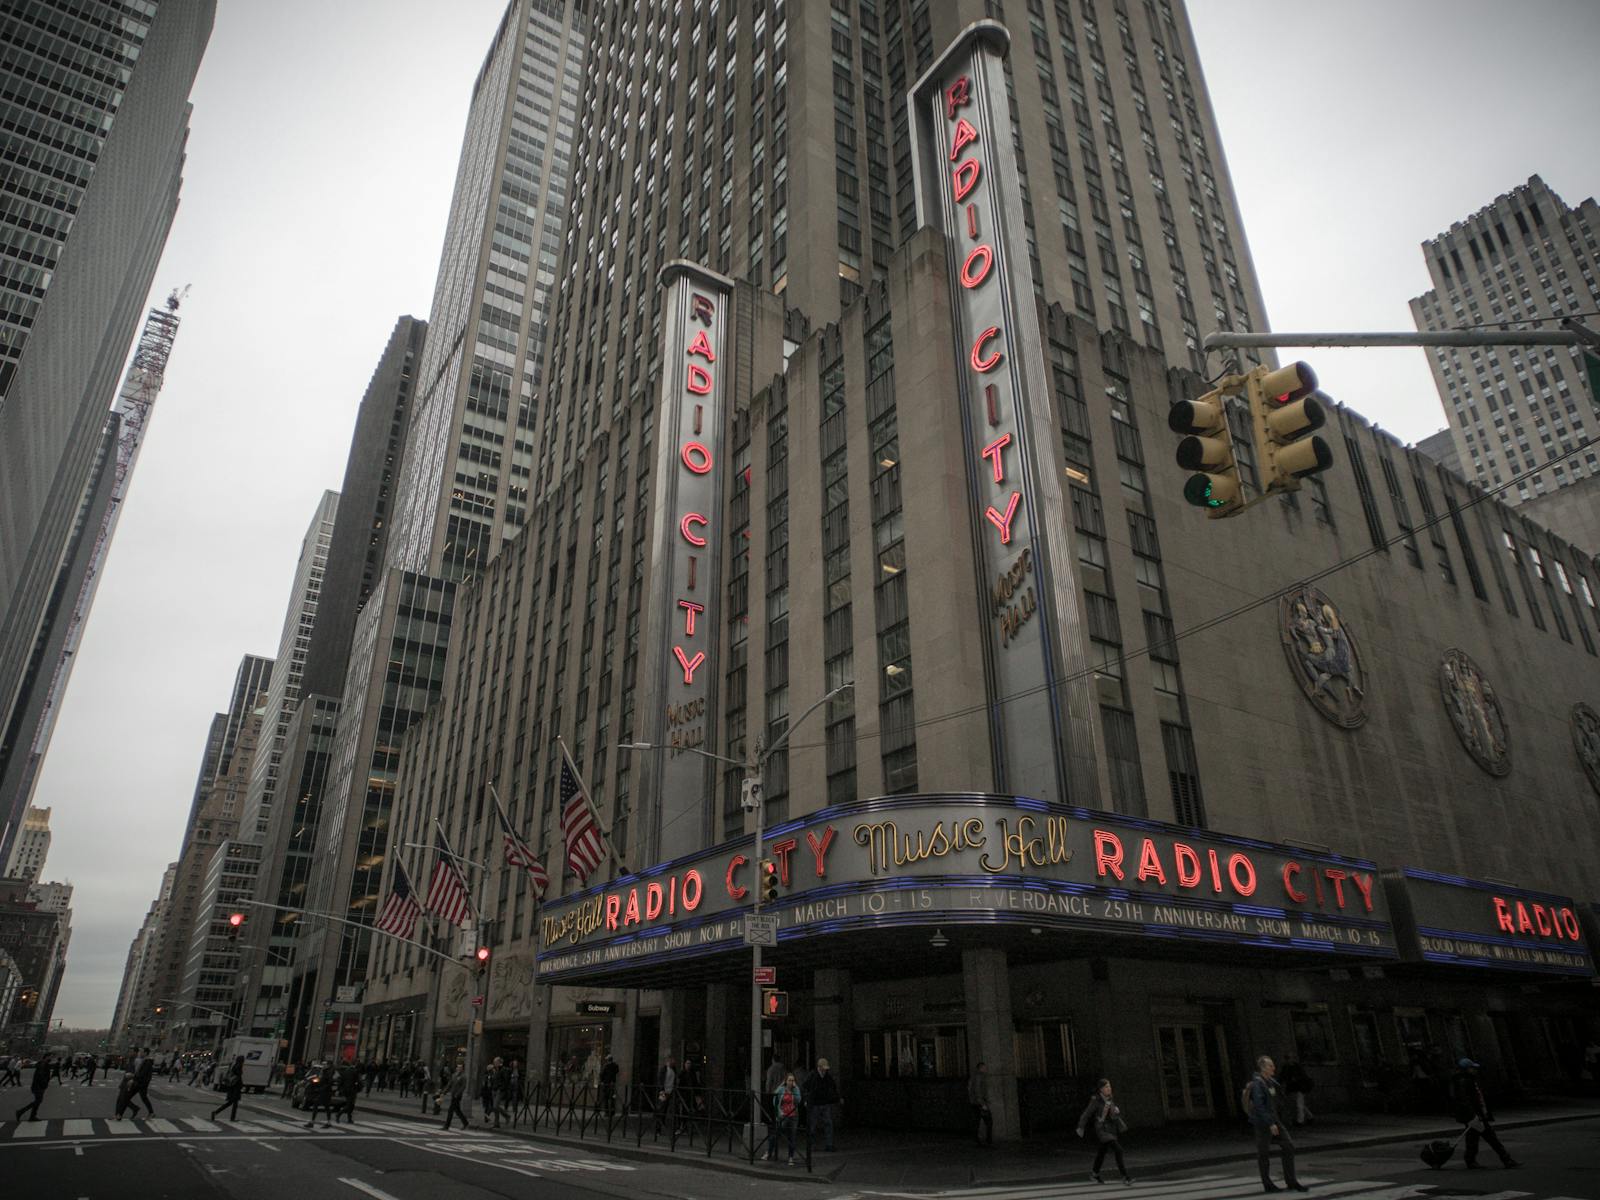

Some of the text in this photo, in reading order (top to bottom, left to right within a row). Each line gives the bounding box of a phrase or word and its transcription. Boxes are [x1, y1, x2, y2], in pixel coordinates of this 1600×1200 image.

[946, 75, 1021, 544] RADIO CITY
[672, 292, 716, 685] RADIO CITY
[606, 824, 837, 931] RADIO CTY
[853, 815, 1073, 875] Music Hall
[1093, 829, 1373, 912] RADIO CITY
[604, 939, 658, 961] ANNIVERSARY
[664, 930, 692, 950] SHOW
[700, 922, 723, 943] NOW
[795, 897, 848, 925] MARCH
[968, 889, 1092, 916] RVERDANCE
[1103, 900, 1143, 921] 25TH
[1153, 905, 1247, 932] ANNIVERSARY
[1256, 917, 1291, 936] SHOW
[1301, 922, 1343, 942] MARCH
[1492, 896, 1580, 941] RADIO
